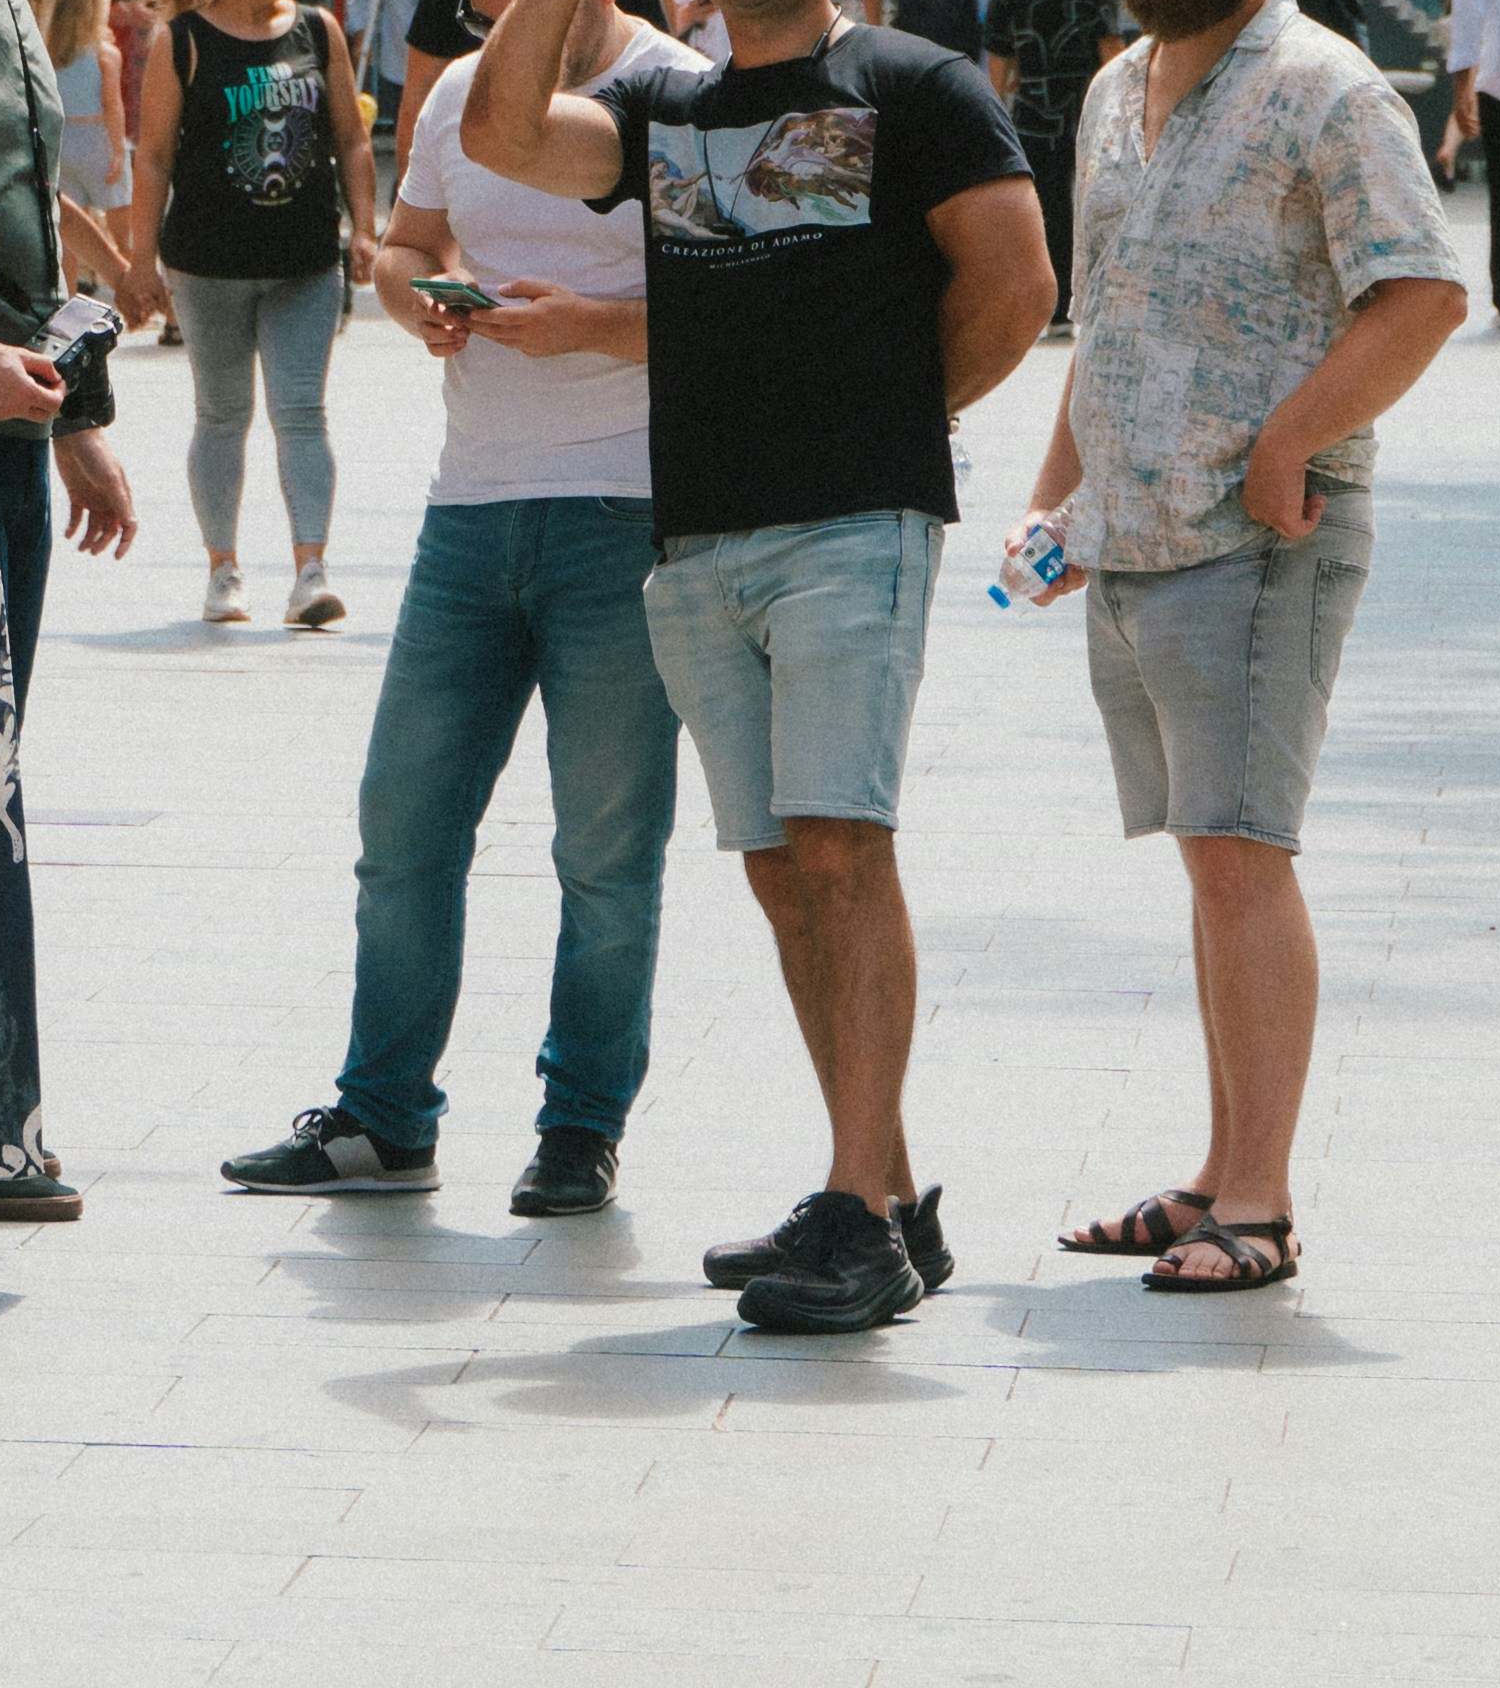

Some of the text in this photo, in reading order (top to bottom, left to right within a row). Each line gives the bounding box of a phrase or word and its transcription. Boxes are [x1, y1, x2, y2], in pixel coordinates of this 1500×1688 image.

[247, 62, 294, 85] FIND
[224, 77, 320, 124] YOURSELF
[661, 232, 824, 257] CREAZIONE DI ADAMO
